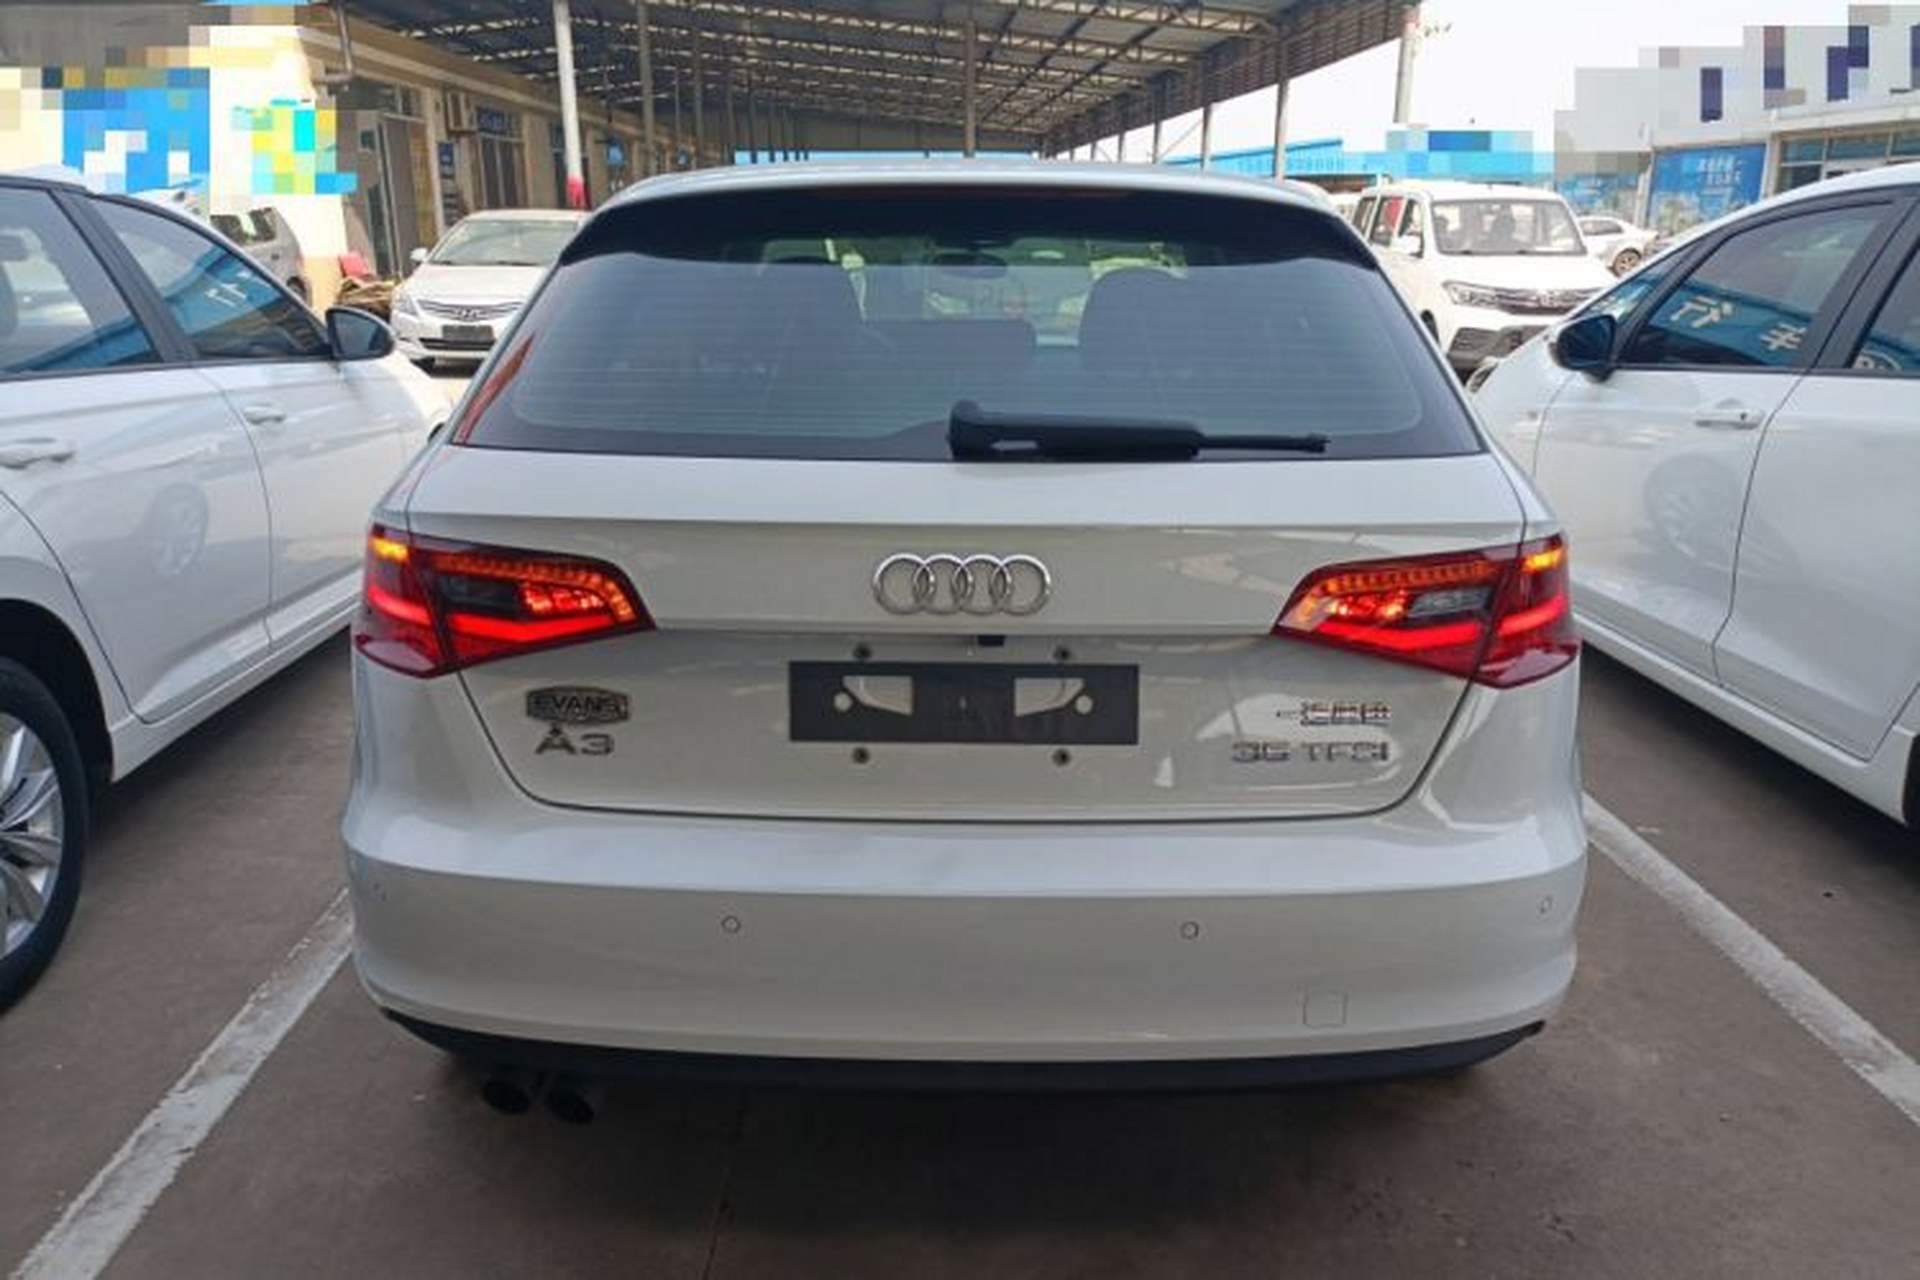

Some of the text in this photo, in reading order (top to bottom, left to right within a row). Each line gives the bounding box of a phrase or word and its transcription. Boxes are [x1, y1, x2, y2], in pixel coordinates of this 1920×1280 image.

[535, 725, 615, 755] A3
[1232, 742, 1389, 762] 35 TFSI
